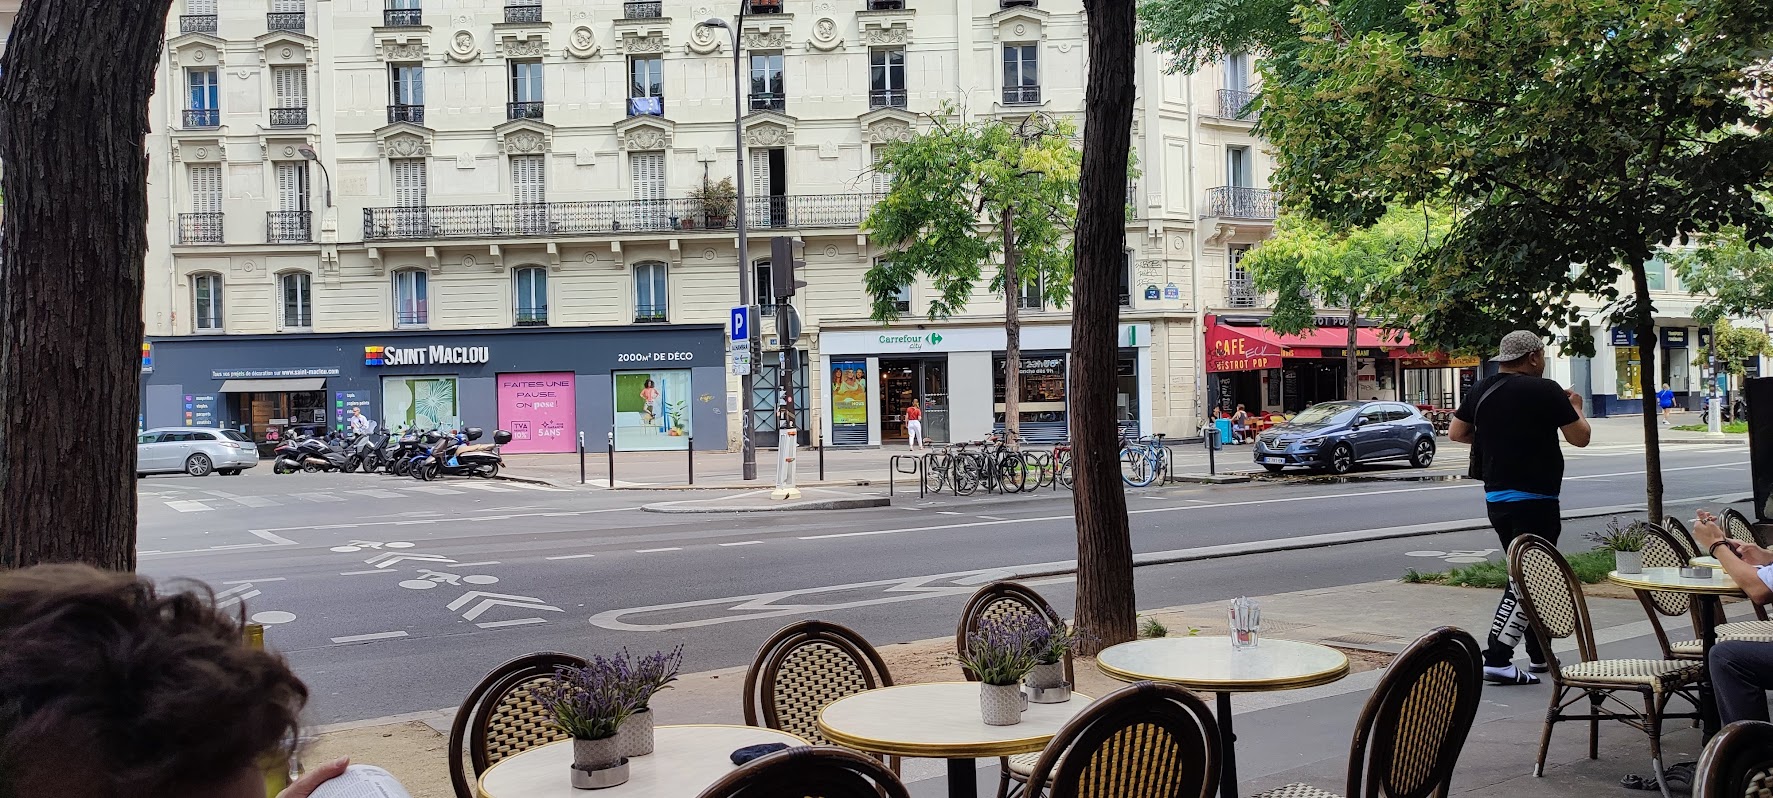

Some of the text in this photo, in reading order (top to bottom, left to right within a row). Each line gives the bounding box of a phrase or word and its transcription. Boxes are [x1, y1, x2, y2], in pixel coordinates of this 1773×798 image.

[734, 313, 744, 335] P
[879, 334, 922, 343] Carrefour
[909, 343, 922, 351] city
[384, 345, 489, 365] SAINT MACLOU
[653, 352, 666, 361] DE
[667, 351, 693, 361] DÉCO
[1253, 358, 1268, 368] POP
[230, 370, 245, 378] projets
[533, 401, 555, 410] pose
[1491, 598, 1516, 637] CONTENT
